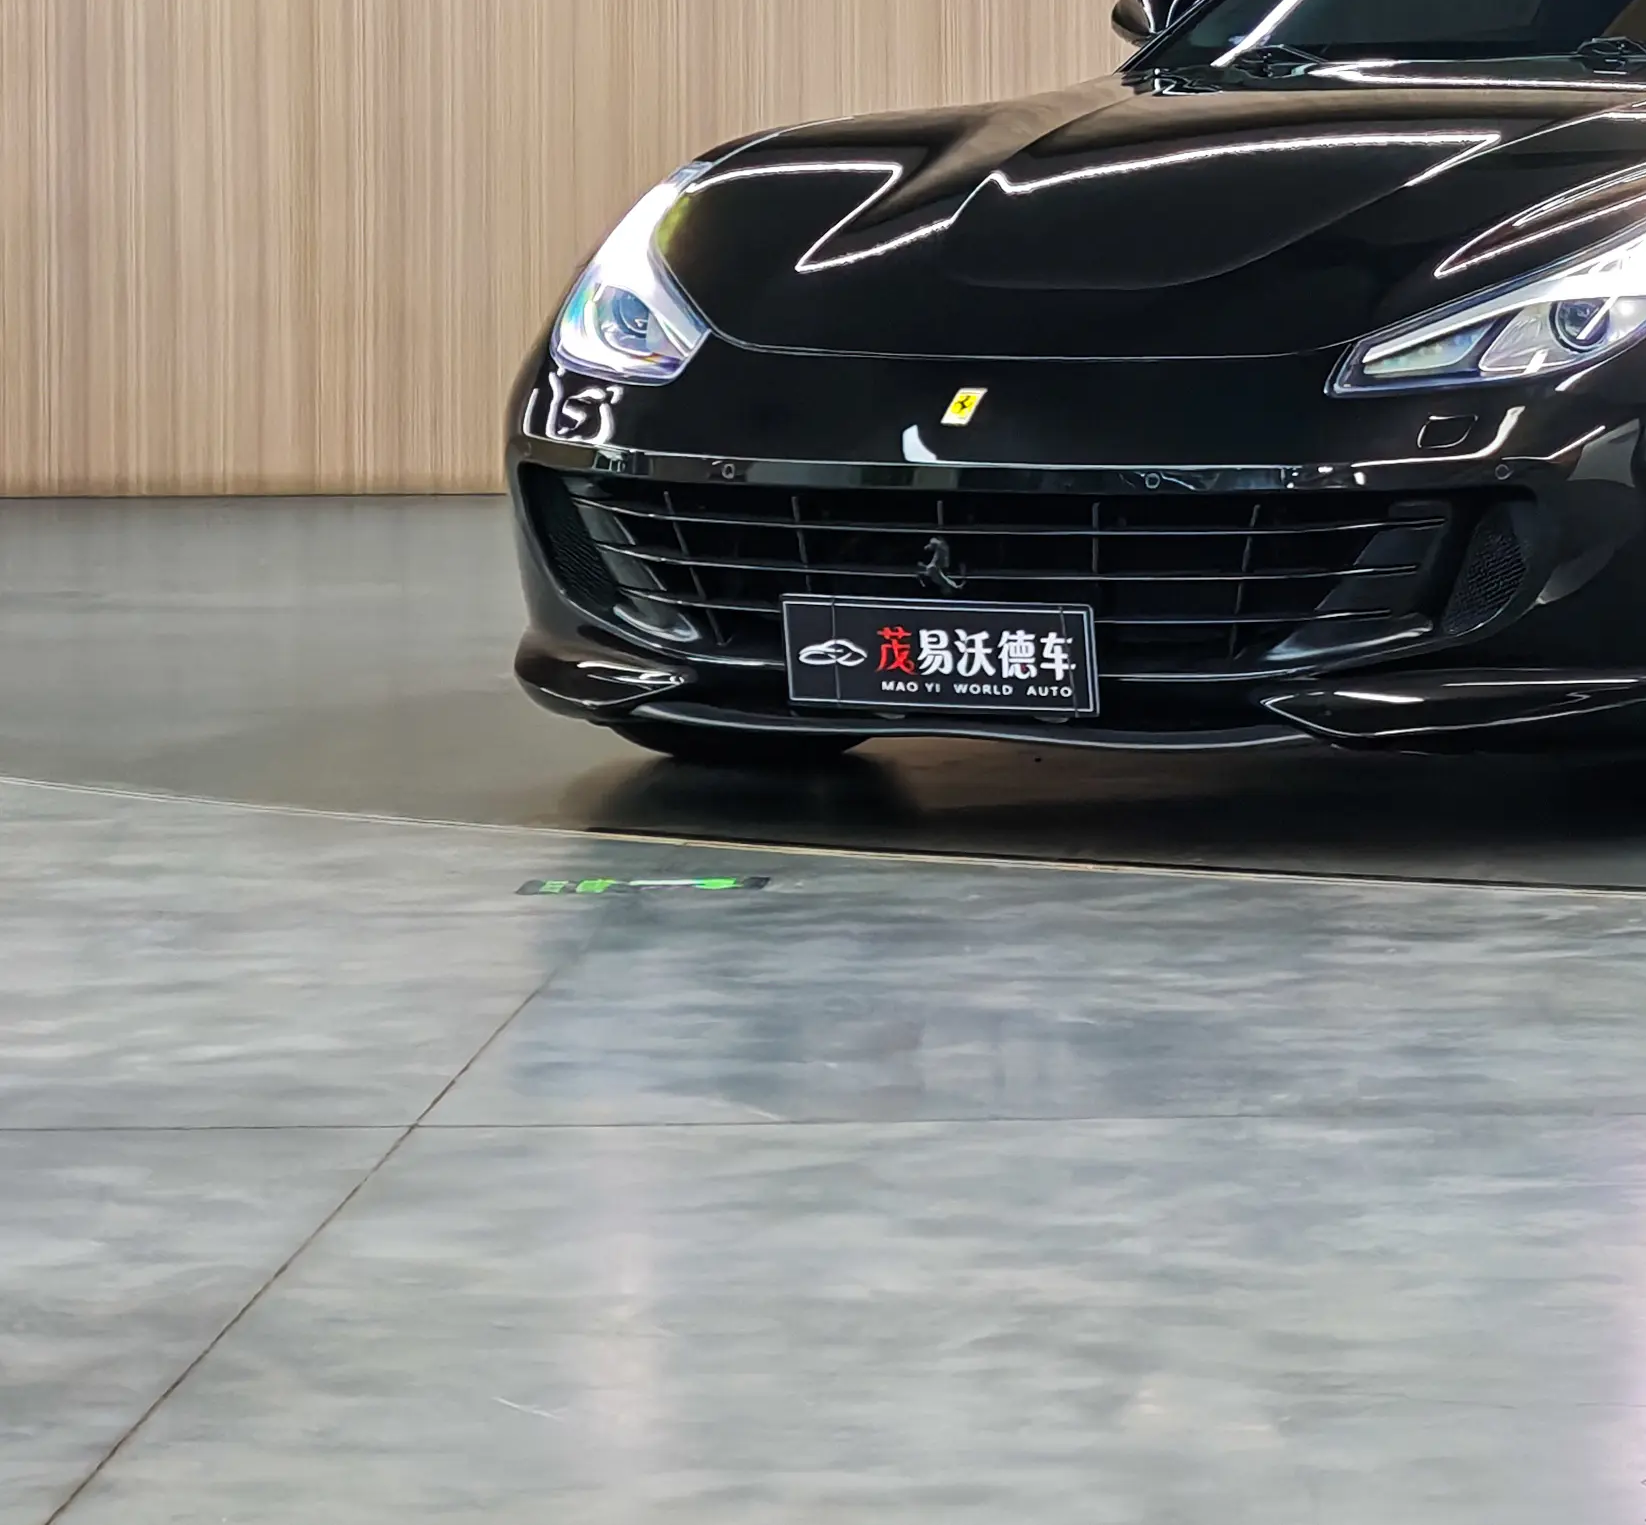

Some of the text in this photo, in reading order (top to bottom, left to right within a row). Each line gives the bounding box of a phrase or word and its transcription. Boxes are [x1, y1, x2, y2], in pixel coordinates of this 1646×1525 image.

[876, 626, 1077, 680] 茂易沃德车
[881, 681, 1073, 698] MAO YI WORLD AUTO
